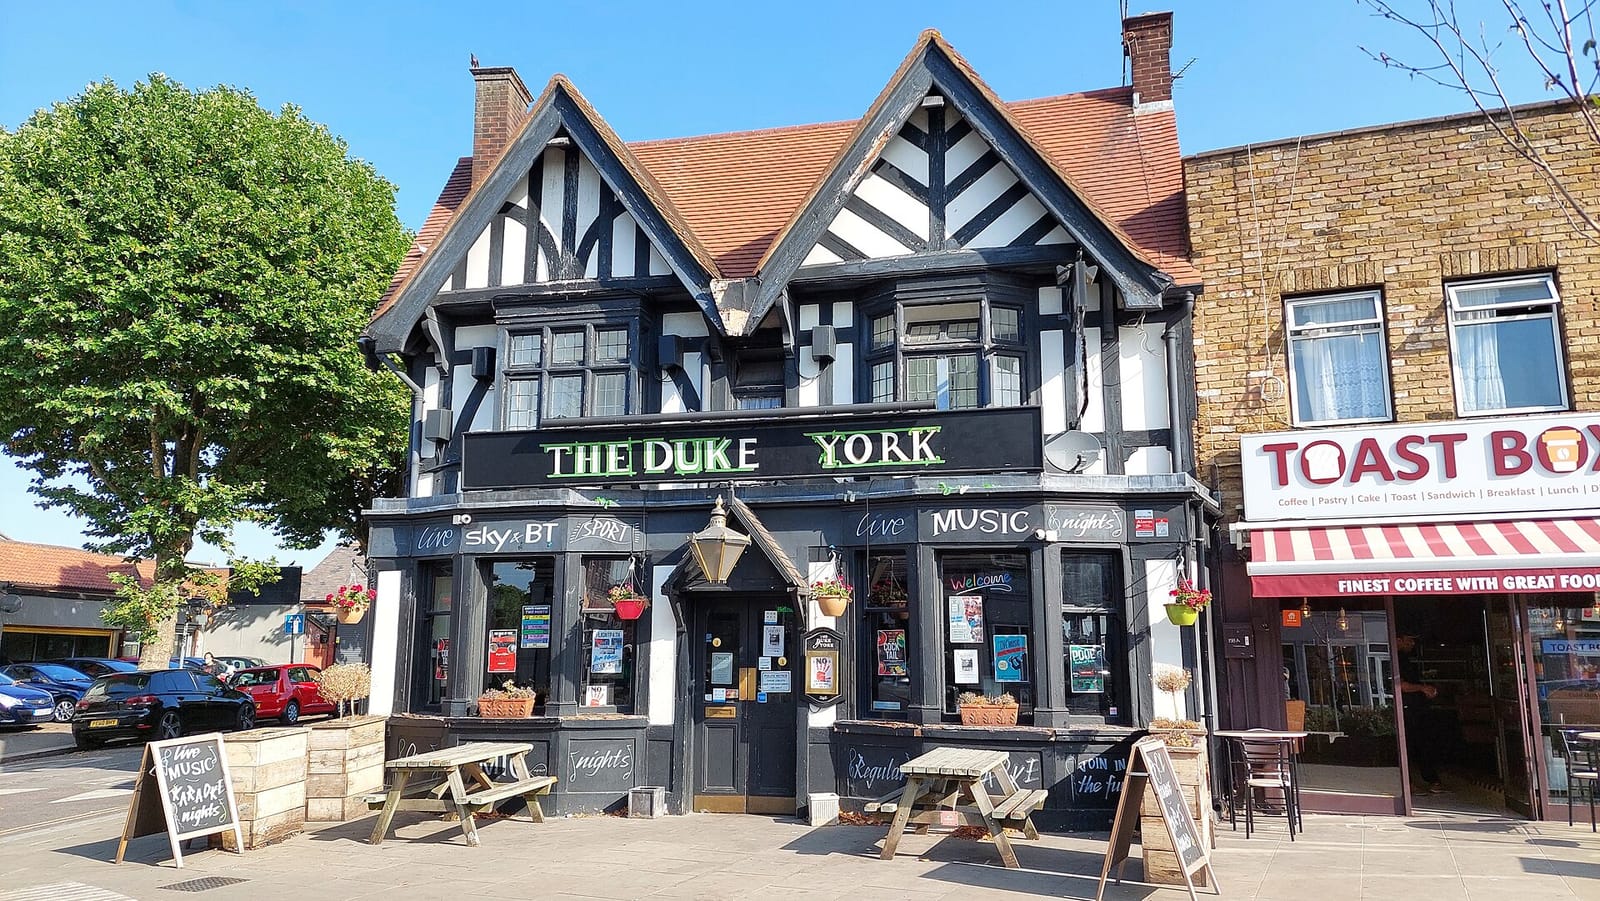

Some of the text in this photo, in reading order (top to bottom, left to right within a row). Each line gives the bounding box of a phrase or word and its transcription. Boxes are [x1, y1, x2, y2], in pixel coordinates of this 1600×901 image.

[542, 428, 942, 476] THE DUKE YORK
[1262, 432, 1468, 486] TOAST
[1278, 484, 1579, 507] Coffee Pastry Cake Toast Sandwich Breakfast Lunch
[855, 508, 1114, 538] live MUSIC nights
[418, 526, 455, 550] live
[465, 525, 512, 552] sky
[525, 522, 559, 544] BT
[582, 518, 629, 543] SPORT
[951, 572, 1012, 591] Welcome
[1338, 579, 1391, 593] FINEST
[1394, 577, 1453, 592] COFFEE
[1456, 576, 1499, 591] WITH
[1503, 575, 1556, 590] GREAT
[1551, 643, 1586, 652] TOAST
[174, 745, 201, 761] live
[575, 751, 630, 777] nights
[168, 758, 215, 781] MUSIC
[1078, 757, 1126, 773] JOIN IN
[168, 779, 226, 808] KARAOKE
[1079, 775, 1103, 793] the
[181, 802, 220, 827] nights
